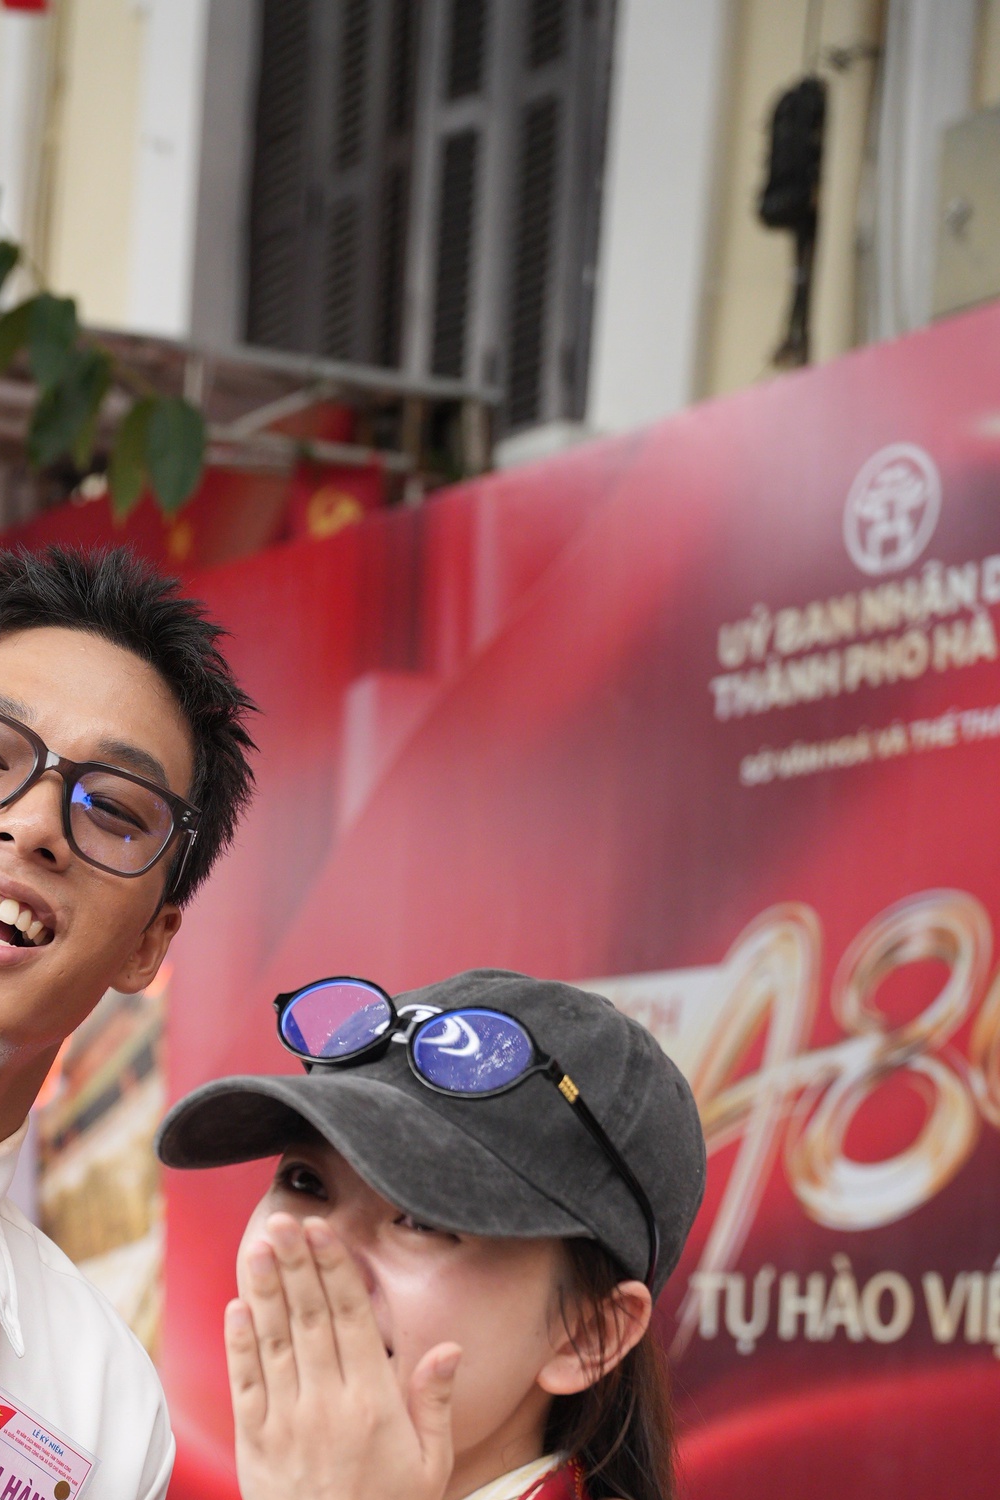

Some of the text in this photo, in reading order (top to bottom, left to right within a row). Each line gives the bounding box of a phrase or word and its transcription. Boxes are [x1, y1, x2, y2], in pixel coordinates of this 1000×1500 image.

[774, 595, 857, 655] BAN
[859, 559, 979, 635] NHÂN
[709, 601, 996, 722] THÀNH PHỐ HÀ
[689, 1262, 775, 1355] TỰ
[778, 1252, 914, 1343] HÀO
